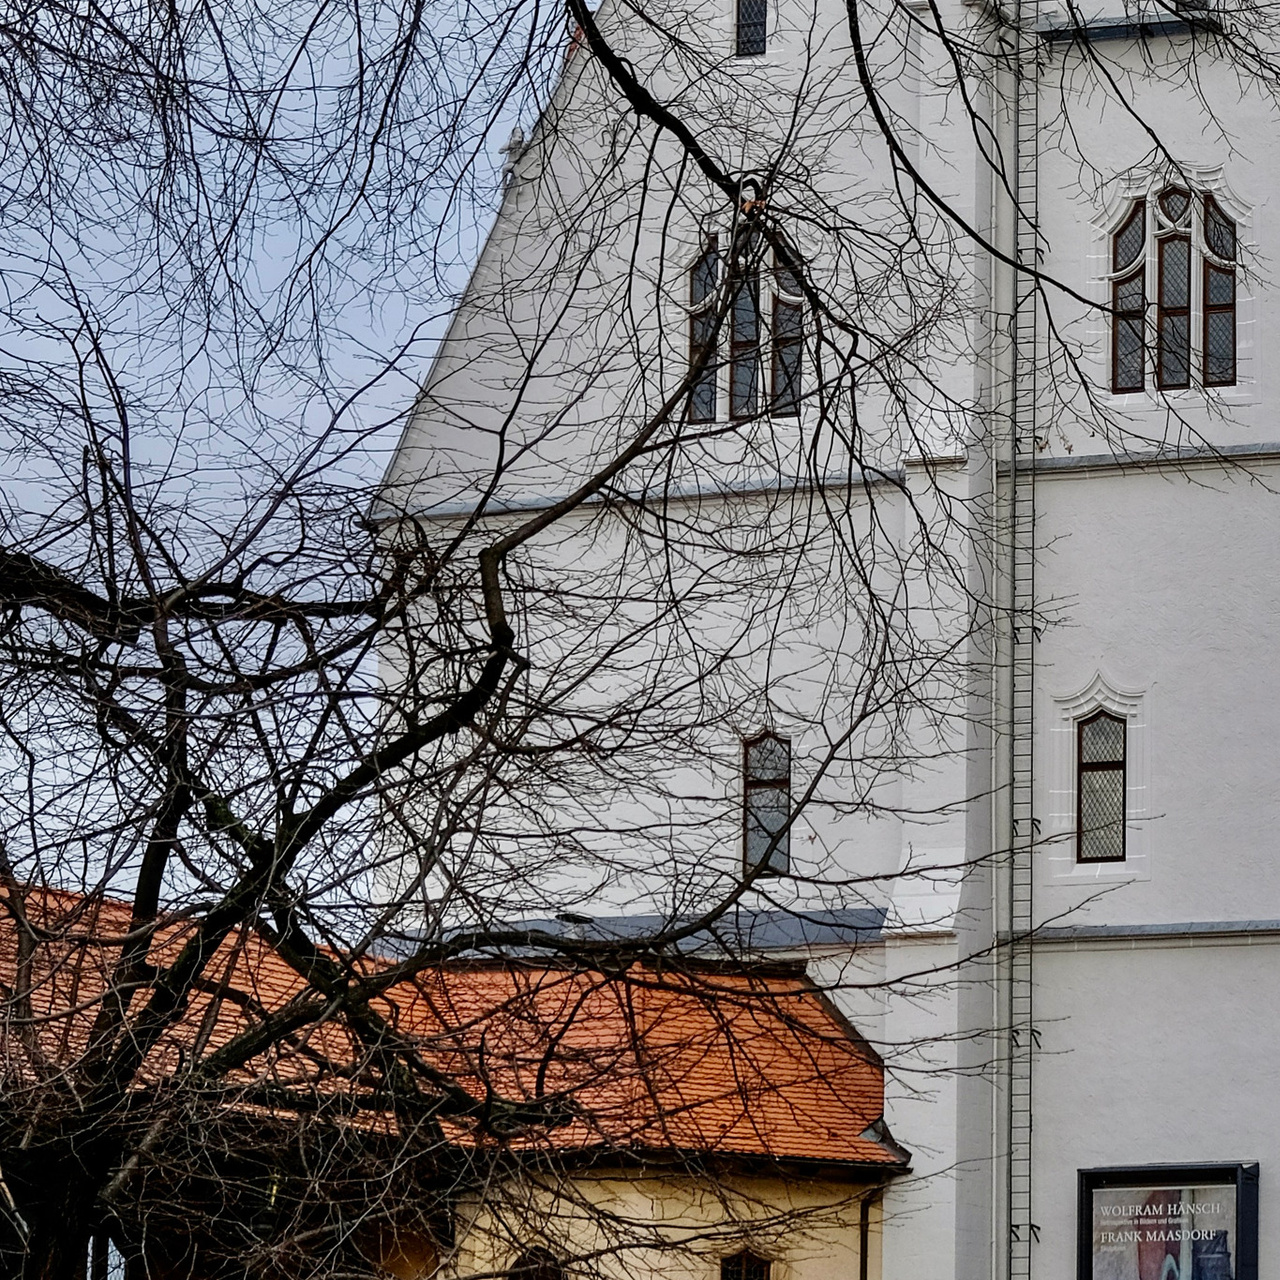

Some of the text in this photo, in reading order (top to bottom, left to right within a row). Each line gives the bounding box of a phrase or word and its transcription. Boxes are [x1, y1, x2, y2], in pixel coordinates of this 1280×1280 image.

[1100, 1201, 1221, 1216] WOLFRAM HÄNSCH
[1100, 1229, 1217, 1243] FRANK MAASDORF
